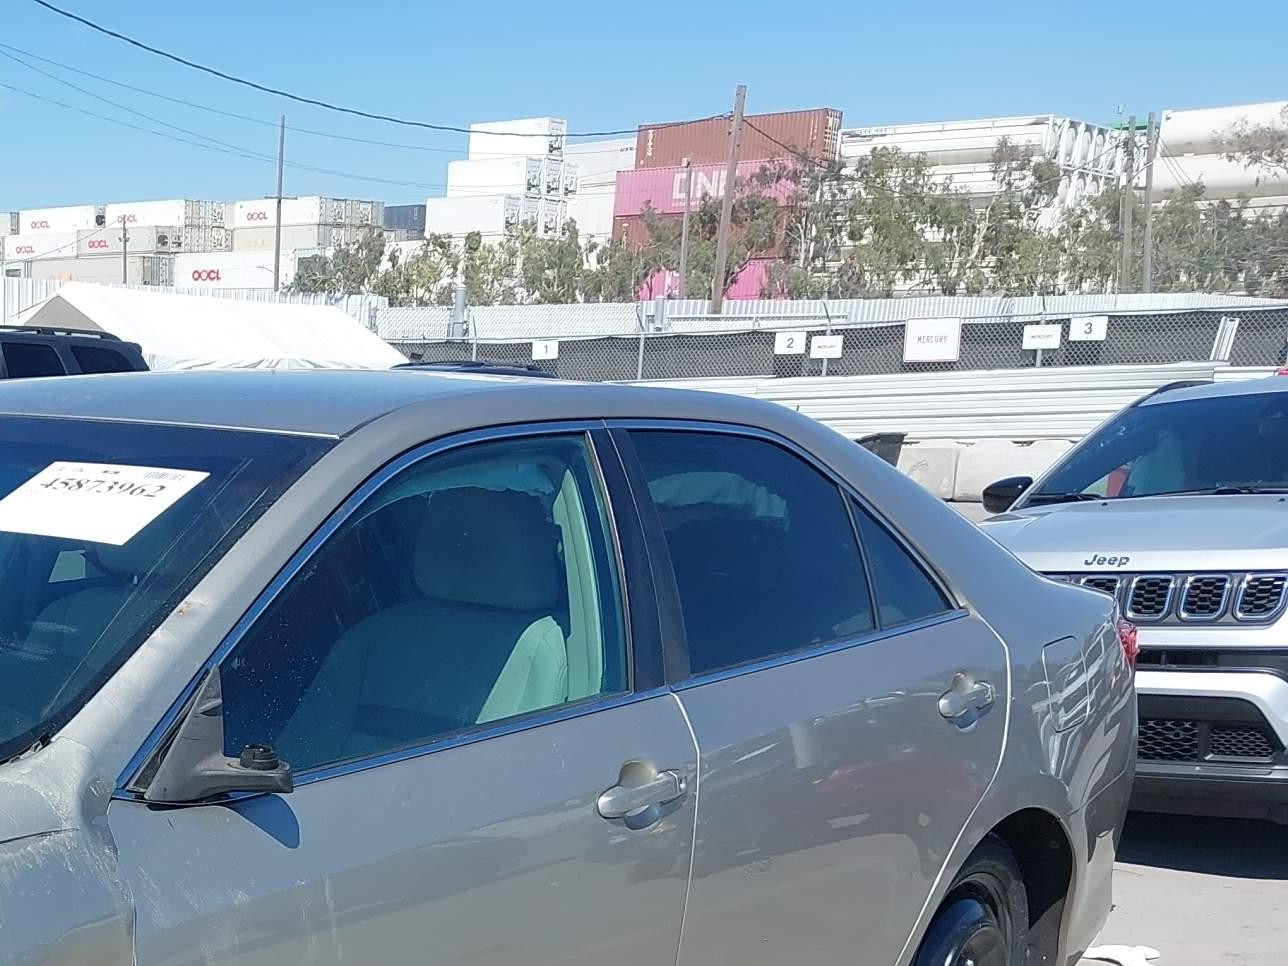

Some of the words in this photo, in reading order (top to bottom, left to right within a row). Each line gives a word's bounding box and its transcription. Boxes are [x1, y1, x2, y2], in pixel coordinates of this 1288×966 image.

[246, 211, 268, 222] OOCL
[31, 221, 50, 230] OOCL
[15, 245, 36, 254] OOCL
[88, 239, 109, 249] OOCL
[192, 269, 221, 282] OOCL
[1083, 322, 1093, 334] 3
[786, 337, 795, 349] 2
[917, 335, 948, 344] MERCURY
[40, 477, 166, 498] 45873962
[1083, 554, 1130, 568] Jeep
